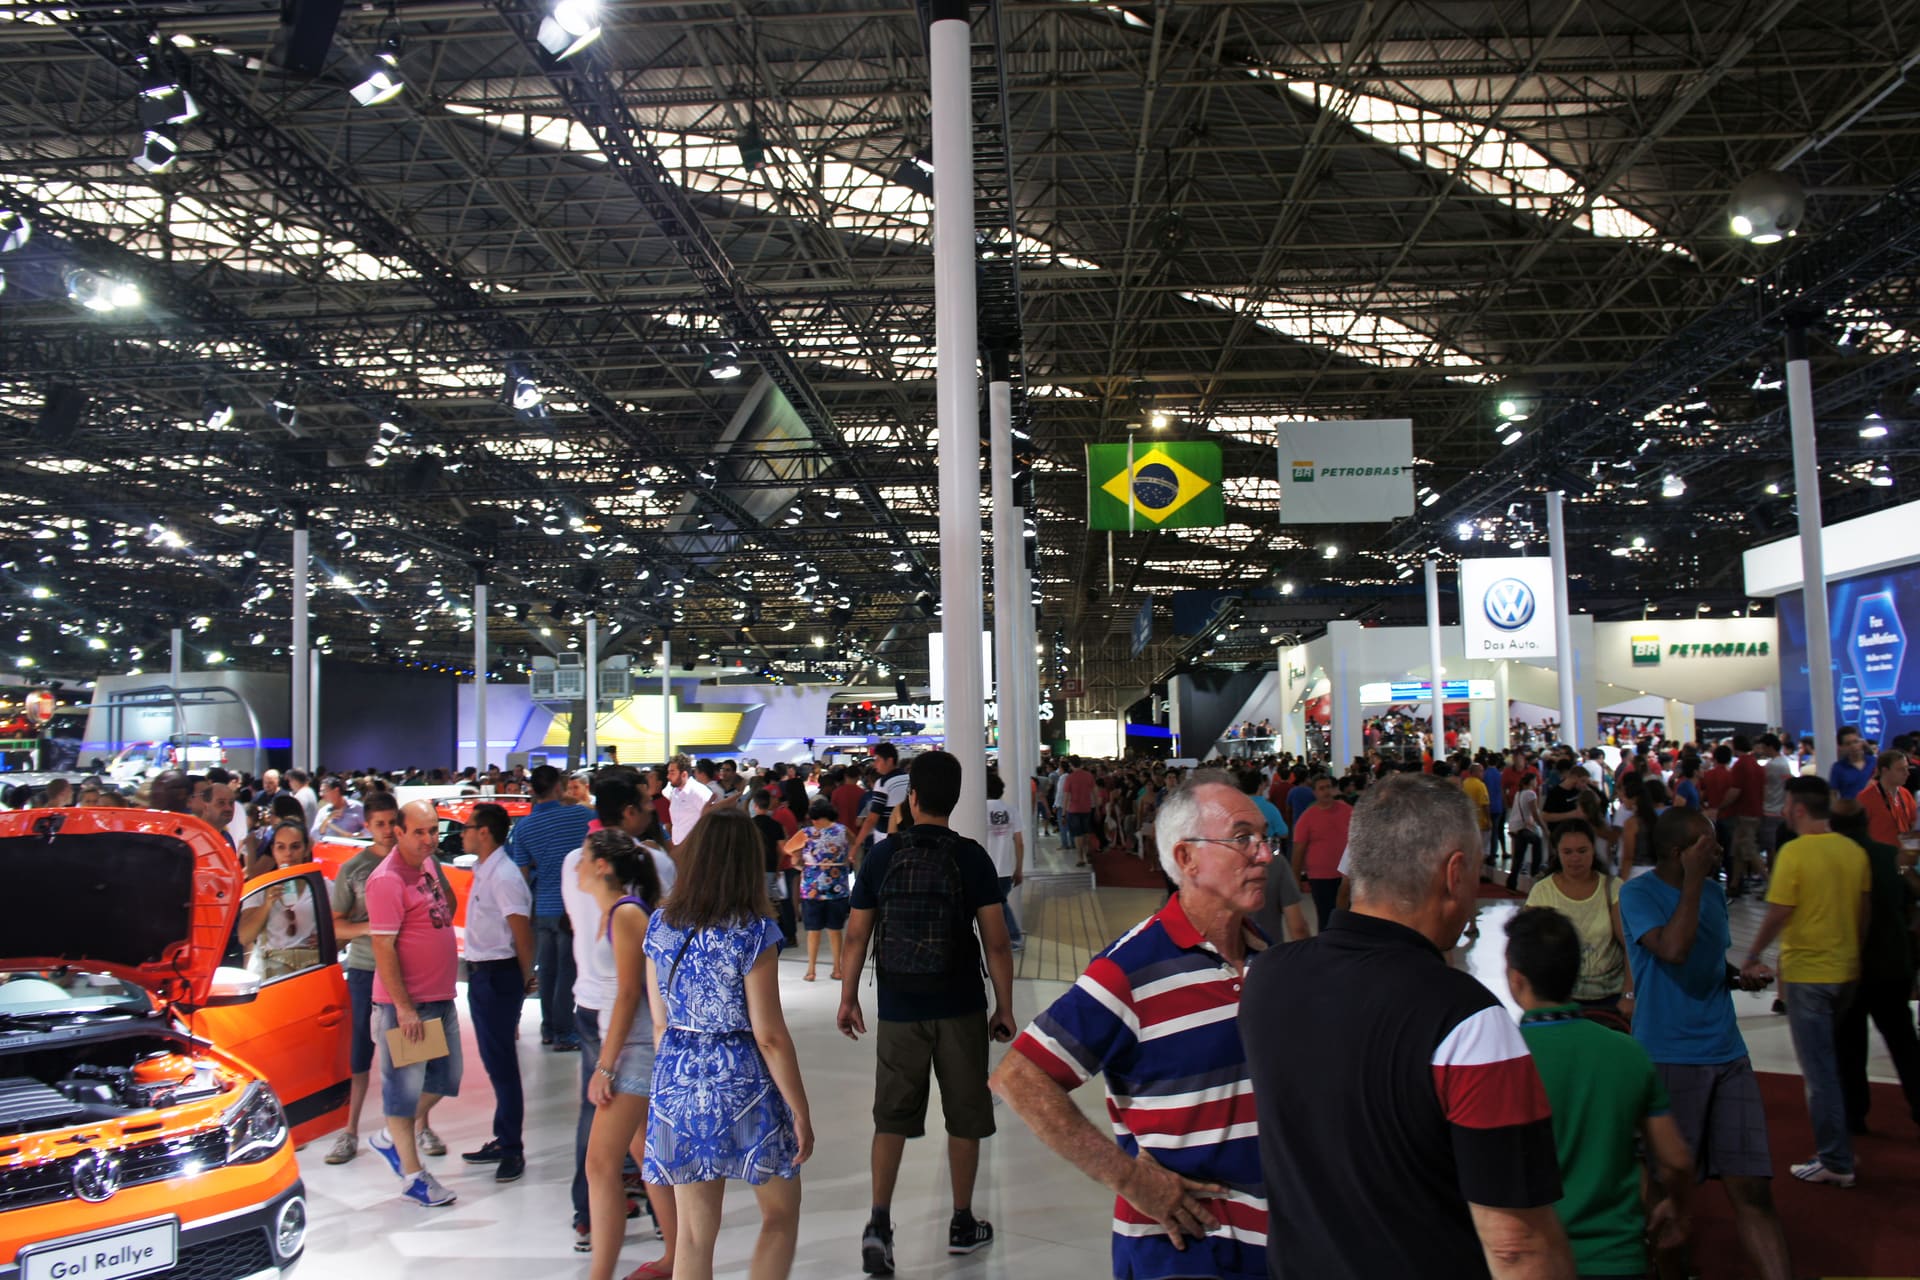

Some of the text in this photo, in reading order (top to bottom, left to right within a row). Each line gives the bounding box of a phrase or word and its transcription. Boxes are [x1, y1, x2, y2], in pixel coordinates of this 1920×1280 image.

[1320, 466, 1400, 477] PETROBRAS
[1483, 639, 1505, 650] Das
[1668, 641, 1770, 658] PETROBRAS
[880, 703, 945, 720] MITSUB
[51, 1245, 154, 1279] Gol Rallye
